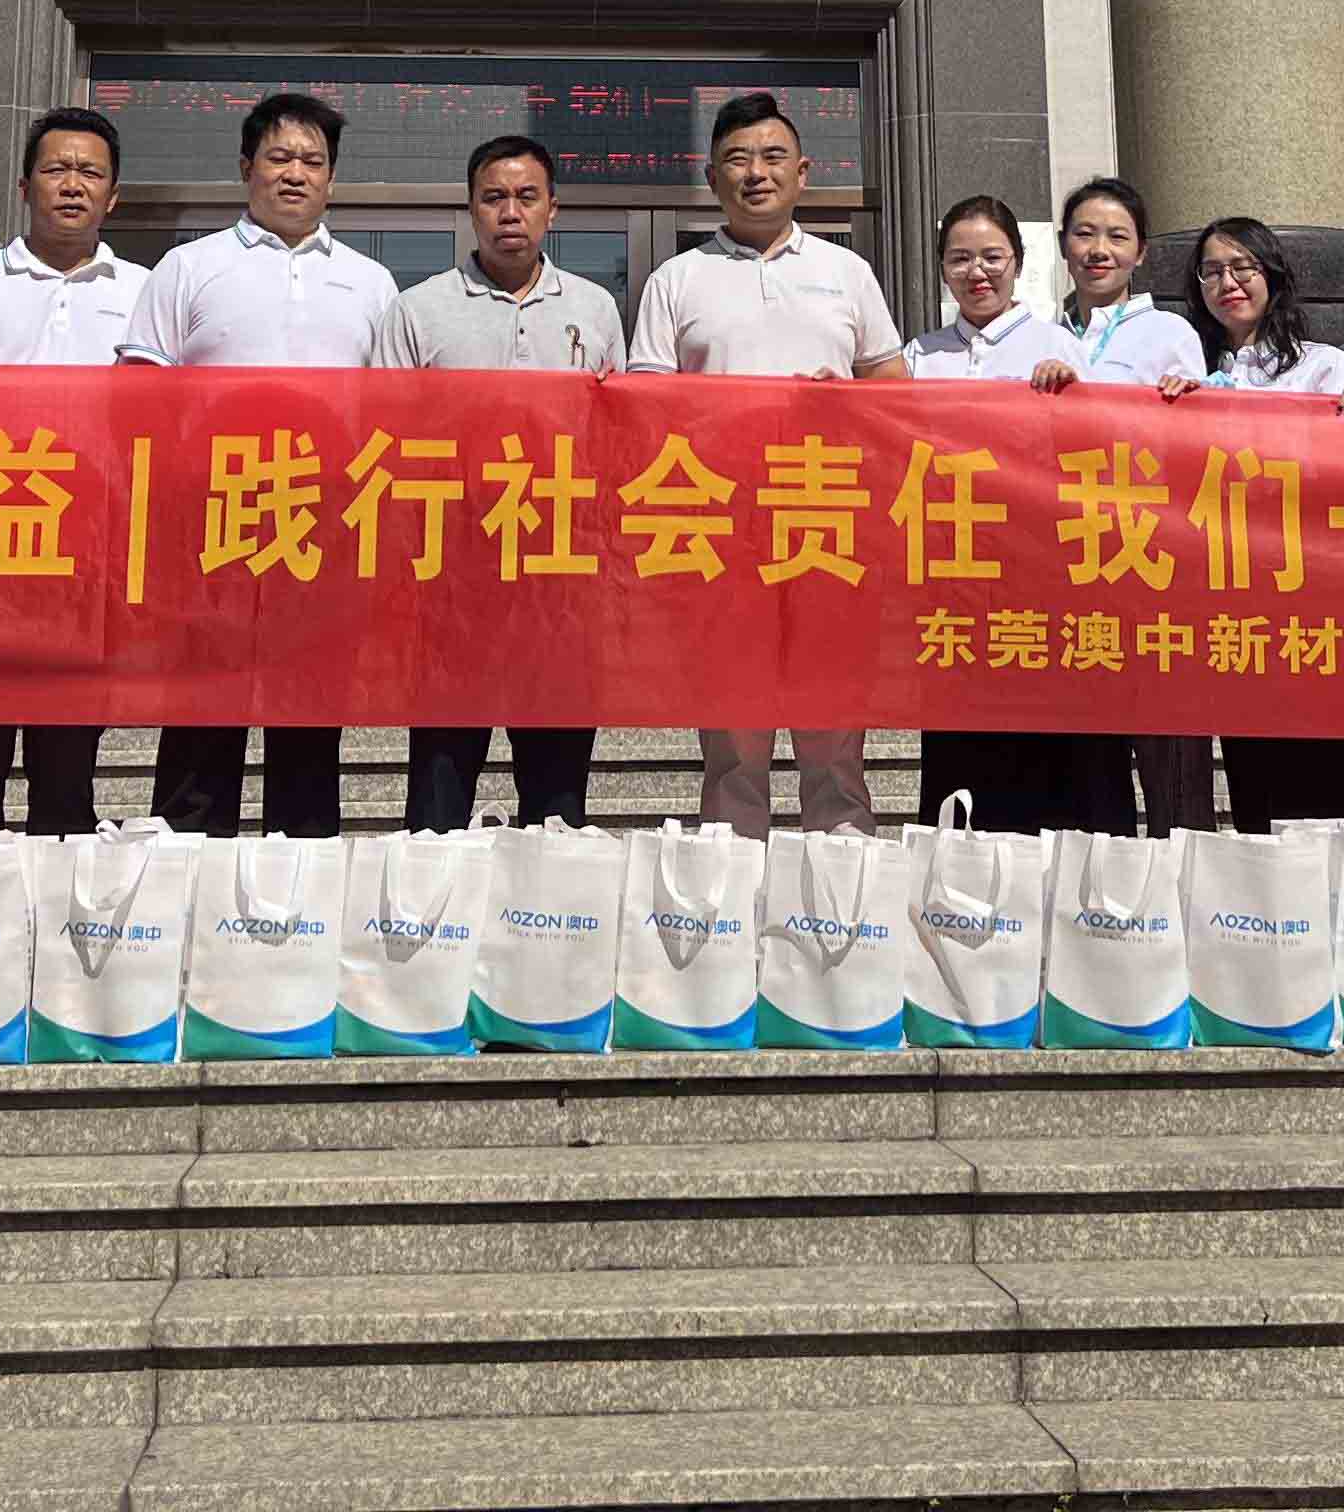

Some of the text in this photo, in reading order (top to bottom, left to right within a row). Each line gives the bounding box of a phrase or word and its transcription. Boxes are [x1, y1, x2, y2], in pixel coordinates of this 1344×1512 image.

[216, 919, 324, 935] AOZON 澳中
[364, 919, 469, 939] AOZON 澳中
[499, 909, 598, 930] AOZON 澳中
[645, 912, 741, 934] AOZON 澳中
[785, 915, 888, 939] AOZON 澳中
[921, 911, 1022, 933] AOZON 澳中
[1074, 912, 1168, 932] AOZON 澳中
[1210, 912, 1310, 934] AOZON 澳中
[59, 921, 161, 941] AOZON 澳中
